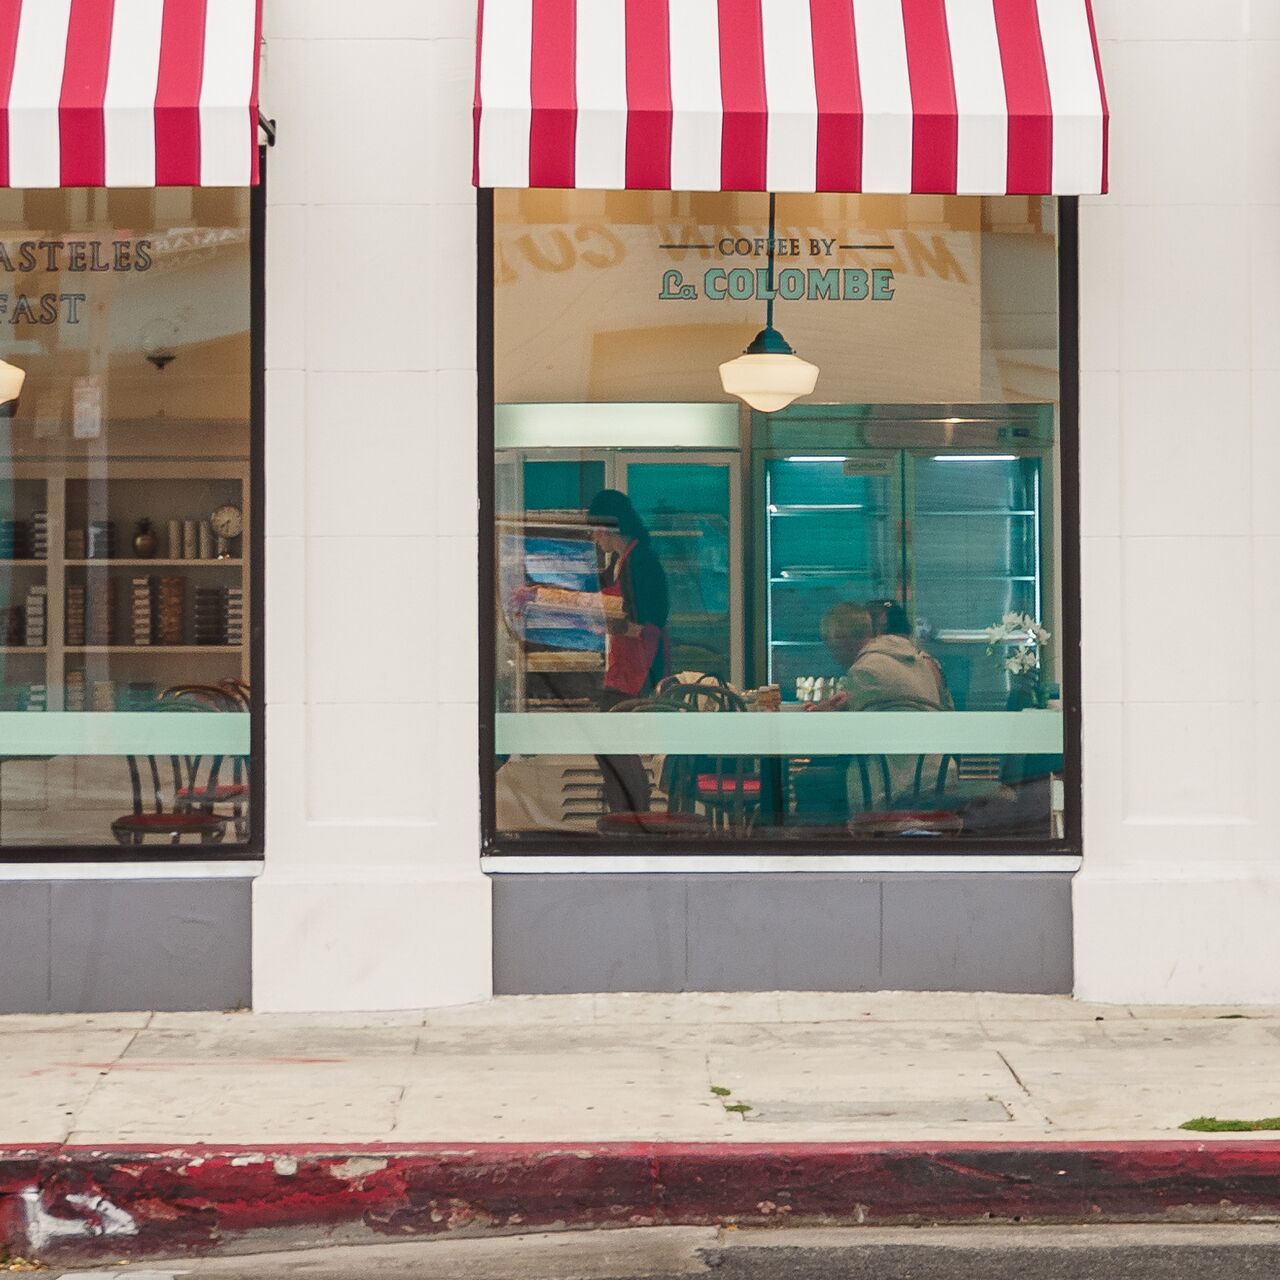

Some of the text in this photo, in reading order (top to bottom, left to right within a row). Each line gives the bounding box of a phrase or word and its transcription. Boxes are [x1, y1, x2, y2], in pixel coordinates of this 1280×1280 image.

[718, 238, 837, 256] COFFEE BY
[658, 268, 895, 301] La COLOMBE
